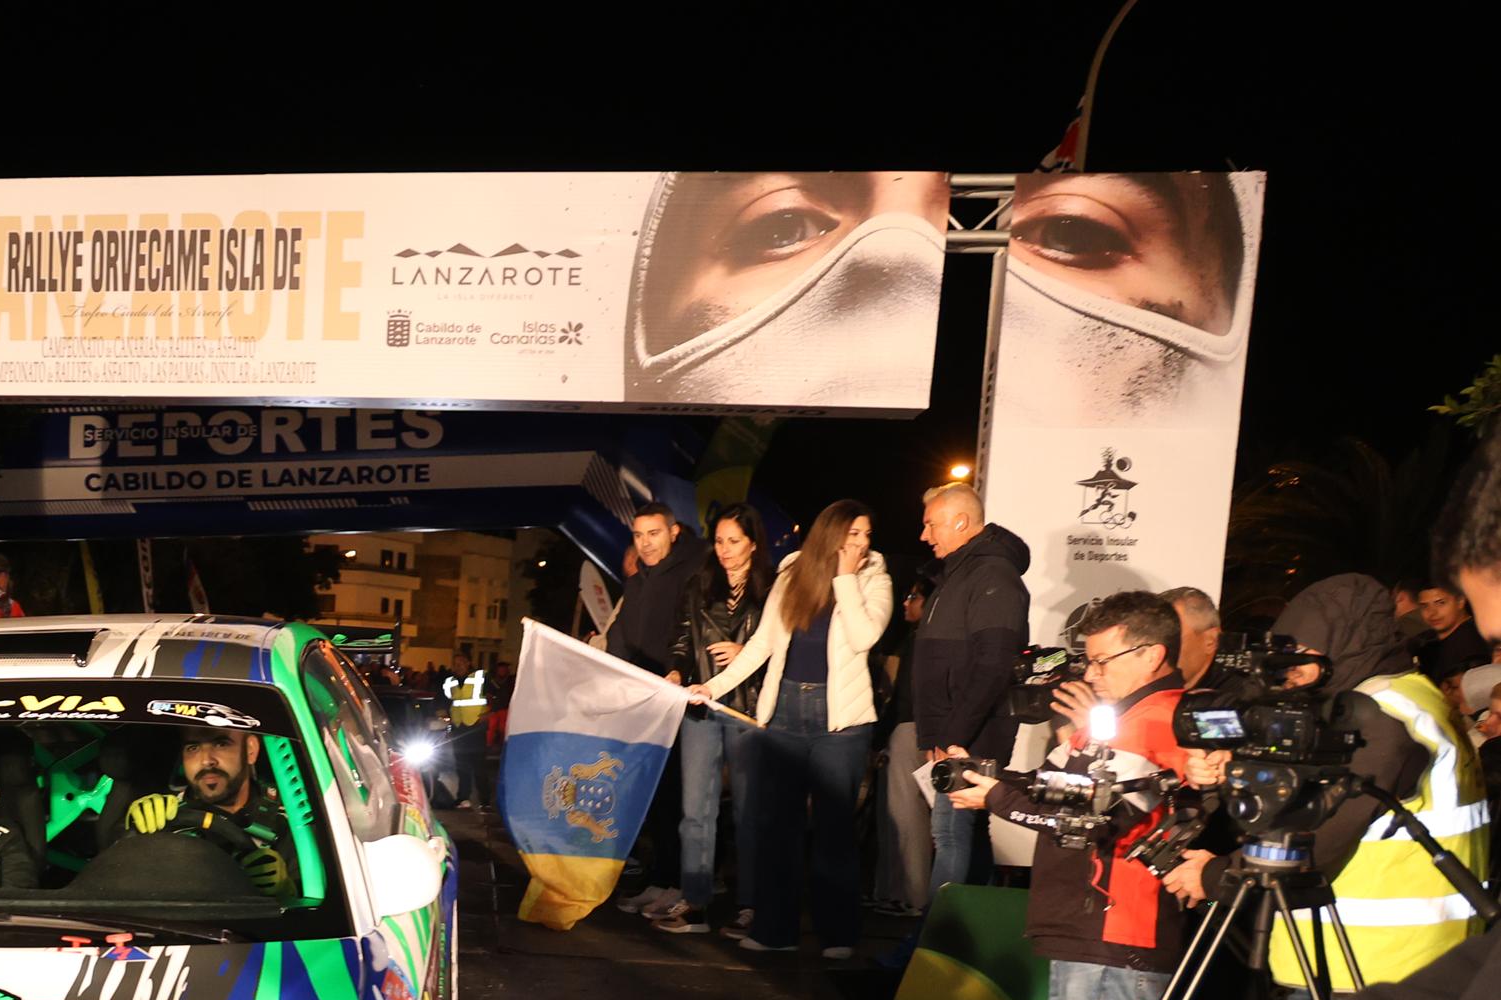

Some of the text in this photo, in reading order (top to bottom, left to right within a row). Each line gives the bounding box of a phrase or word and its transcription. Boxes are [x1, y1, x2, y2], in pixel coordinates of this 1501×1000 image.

[7, 227, 302, 293] RALLYE ORVECAME ISLA DE
[391, 266, 583, 286] LANZAROTE
[415, 322, 483, 334] Cabildo de
[522, 321, 557, 334] Islas
[415, 334, 478, 346] Lanzarote
[490, 333, 556, 345] Canarias
[68, 409, 445, 460] DEPORTES
[84, 424, 258, 442] SERVICIO INSULAR DE
[84, 463, 431, 492] CABILDO DE LANZAROTE
